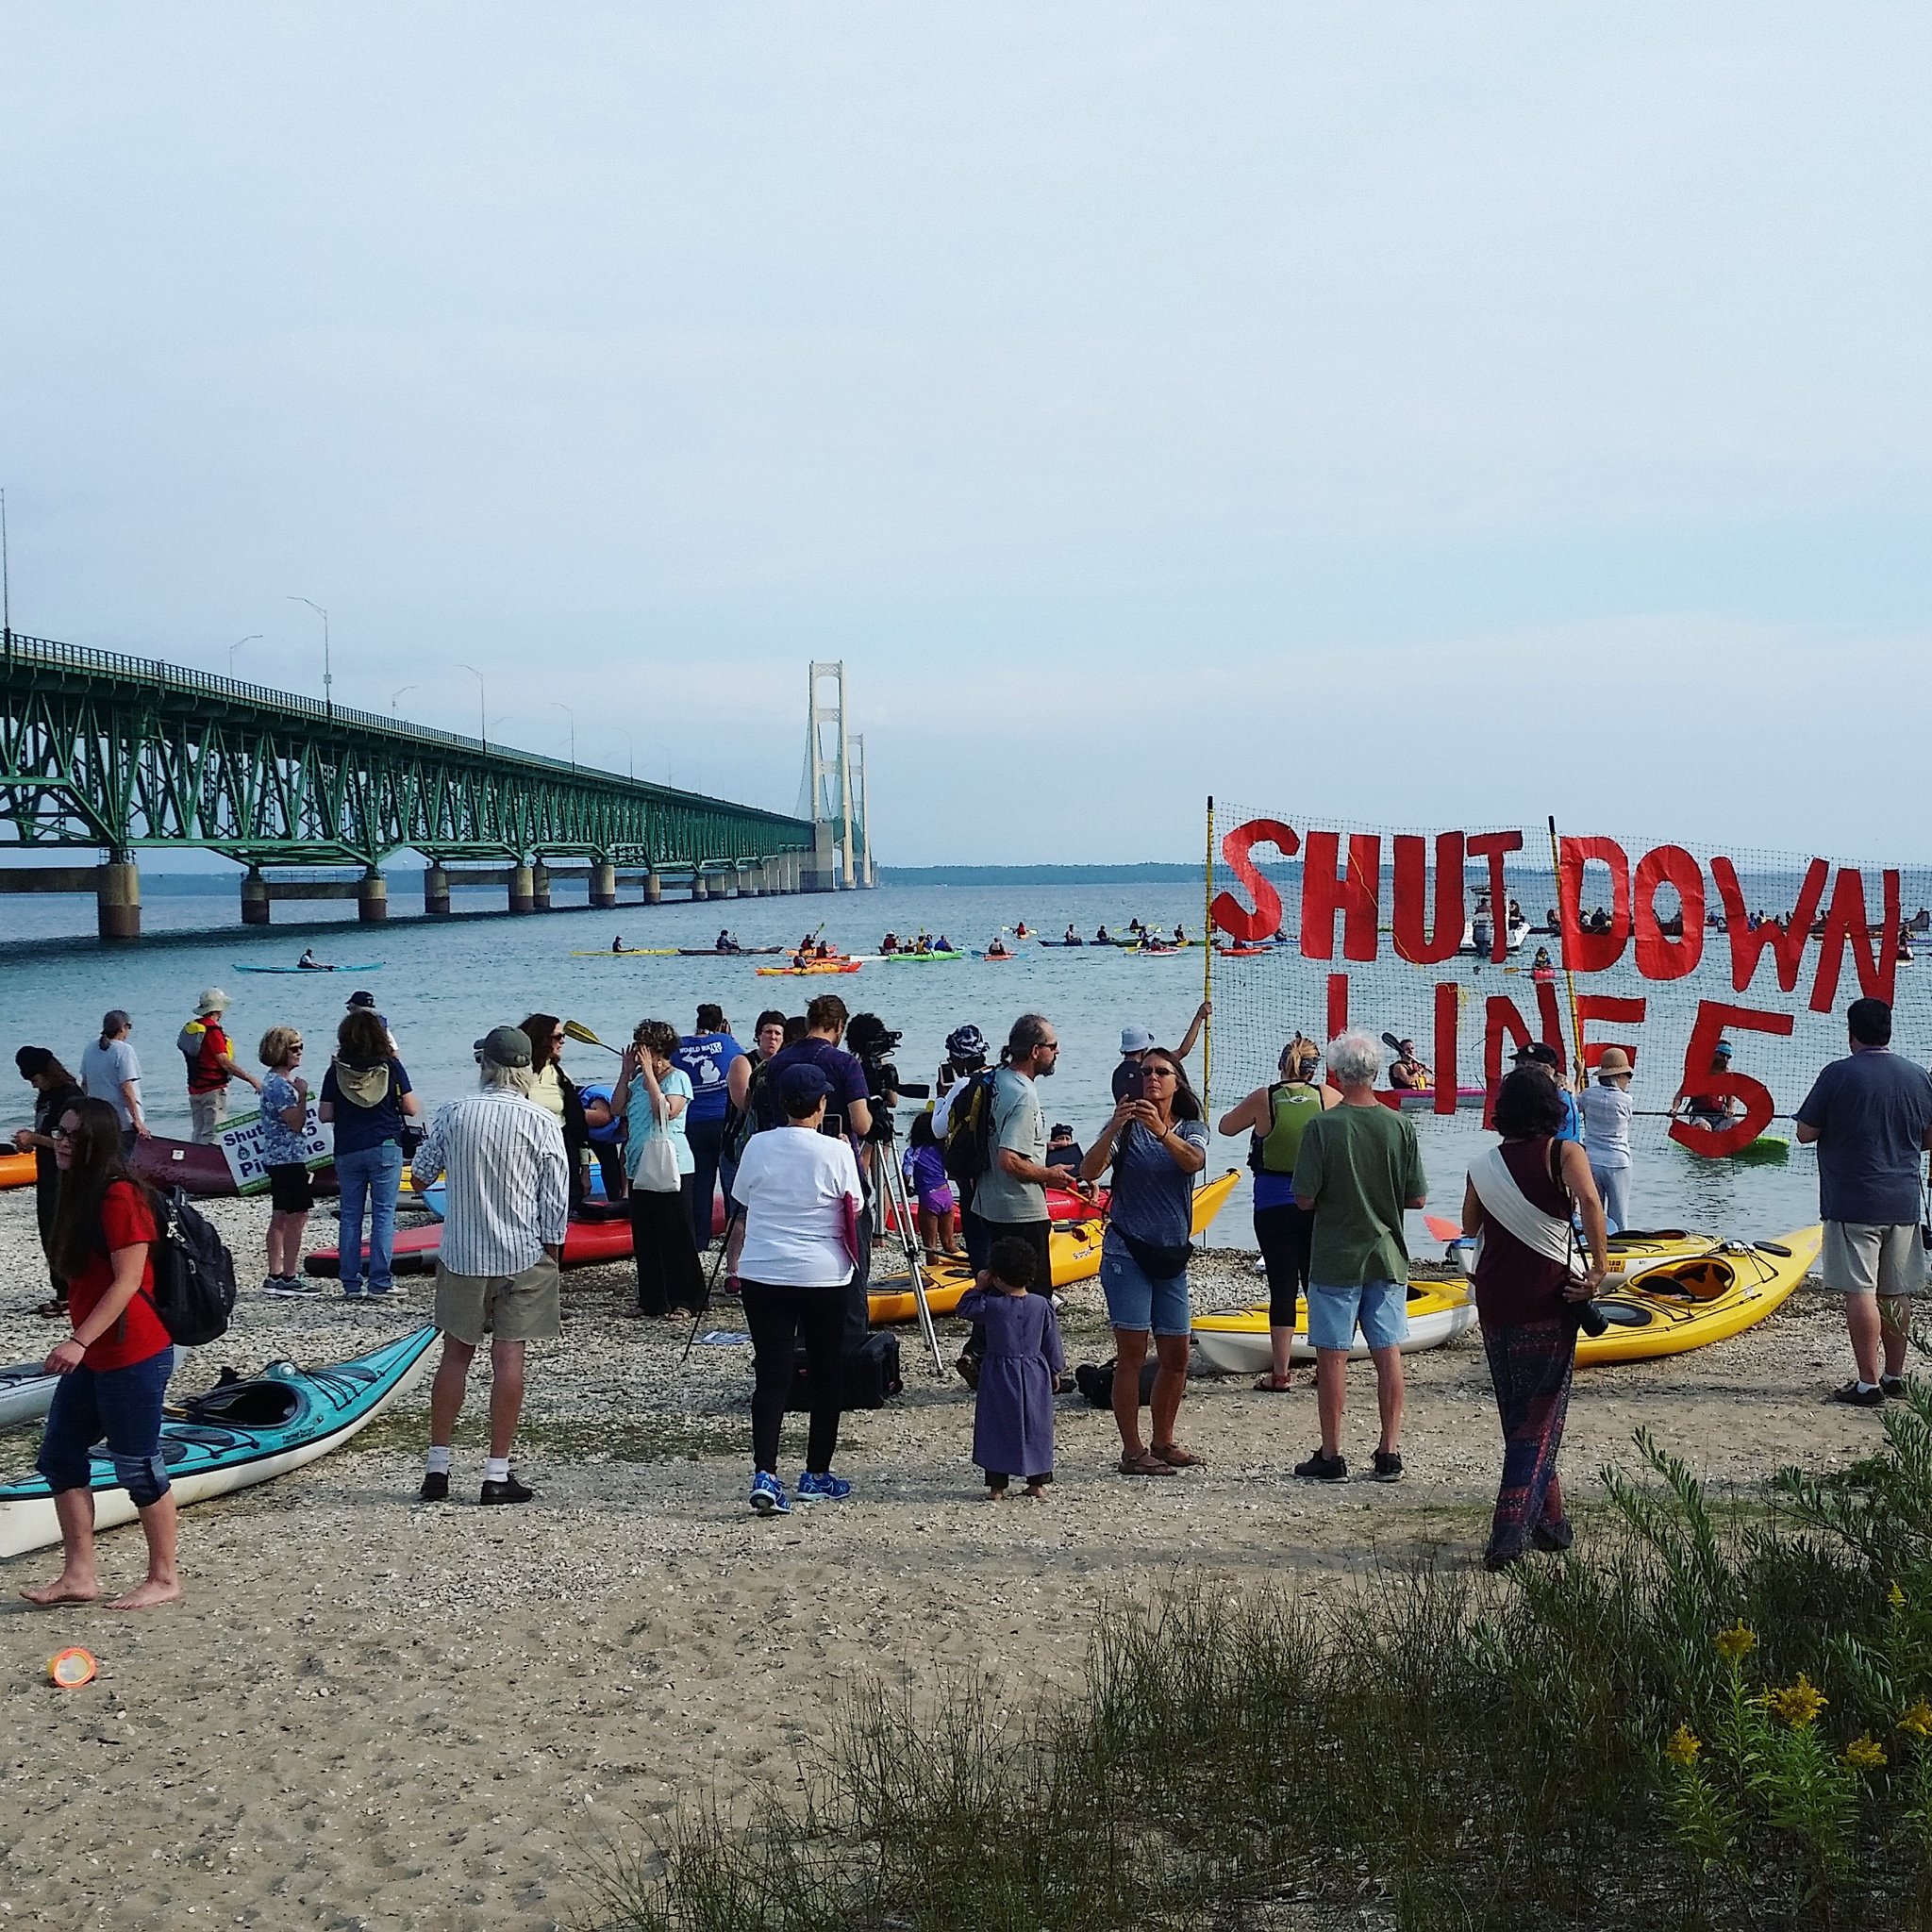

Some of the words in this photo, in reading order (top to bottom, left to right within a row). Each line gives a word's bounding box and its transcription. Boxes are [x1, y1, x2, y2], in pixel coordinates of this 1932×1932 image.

[1209, 818, 1524, 965] SHUT
[1559, 836, 1901, 1014] DOWN
[701, 1041, 722, 1052] WATER
[710, 1046, 723, 1055] DAY
[1668, 998, 1795, 1158] 5
[224, 1124, 265, 1147] Shut
[306, 1121, 318, 1137] 5
